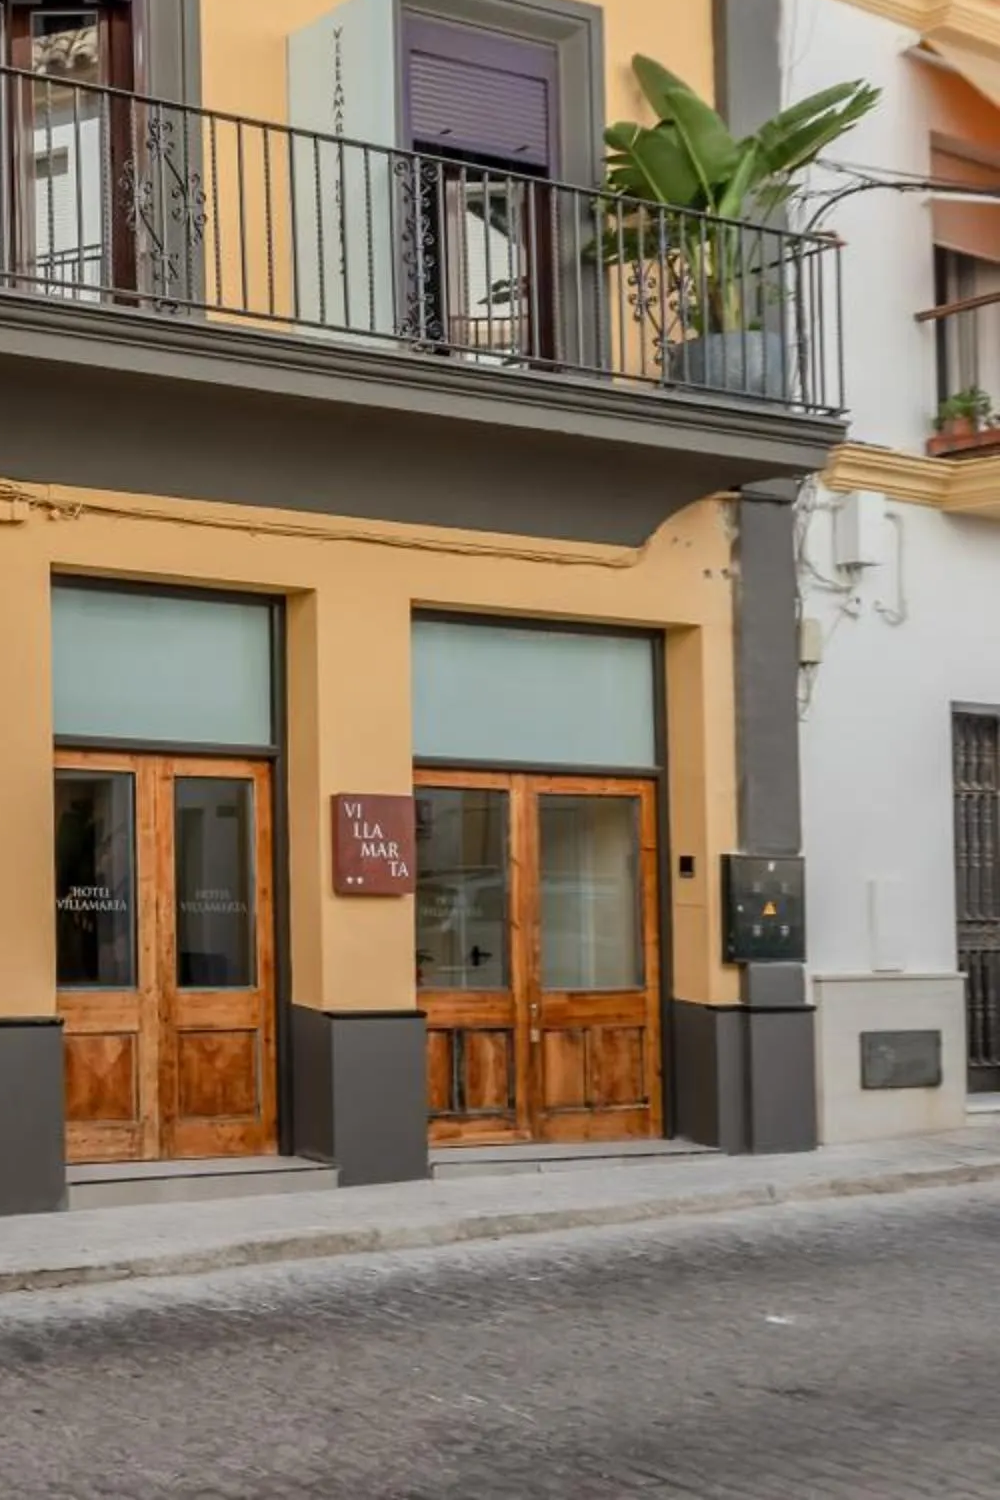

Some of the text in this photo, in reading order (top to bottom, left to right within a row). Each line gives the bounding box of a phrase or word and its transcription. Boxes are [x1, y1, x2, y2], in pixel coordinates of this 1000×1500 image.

[343, 802, 361, 819] VI
[353, 821, 383, 839] LLA
[361, 842, 399, 859] MAR
[387, 861, 409, 877] TA
[72, 886, 111, 898] HOTEL
